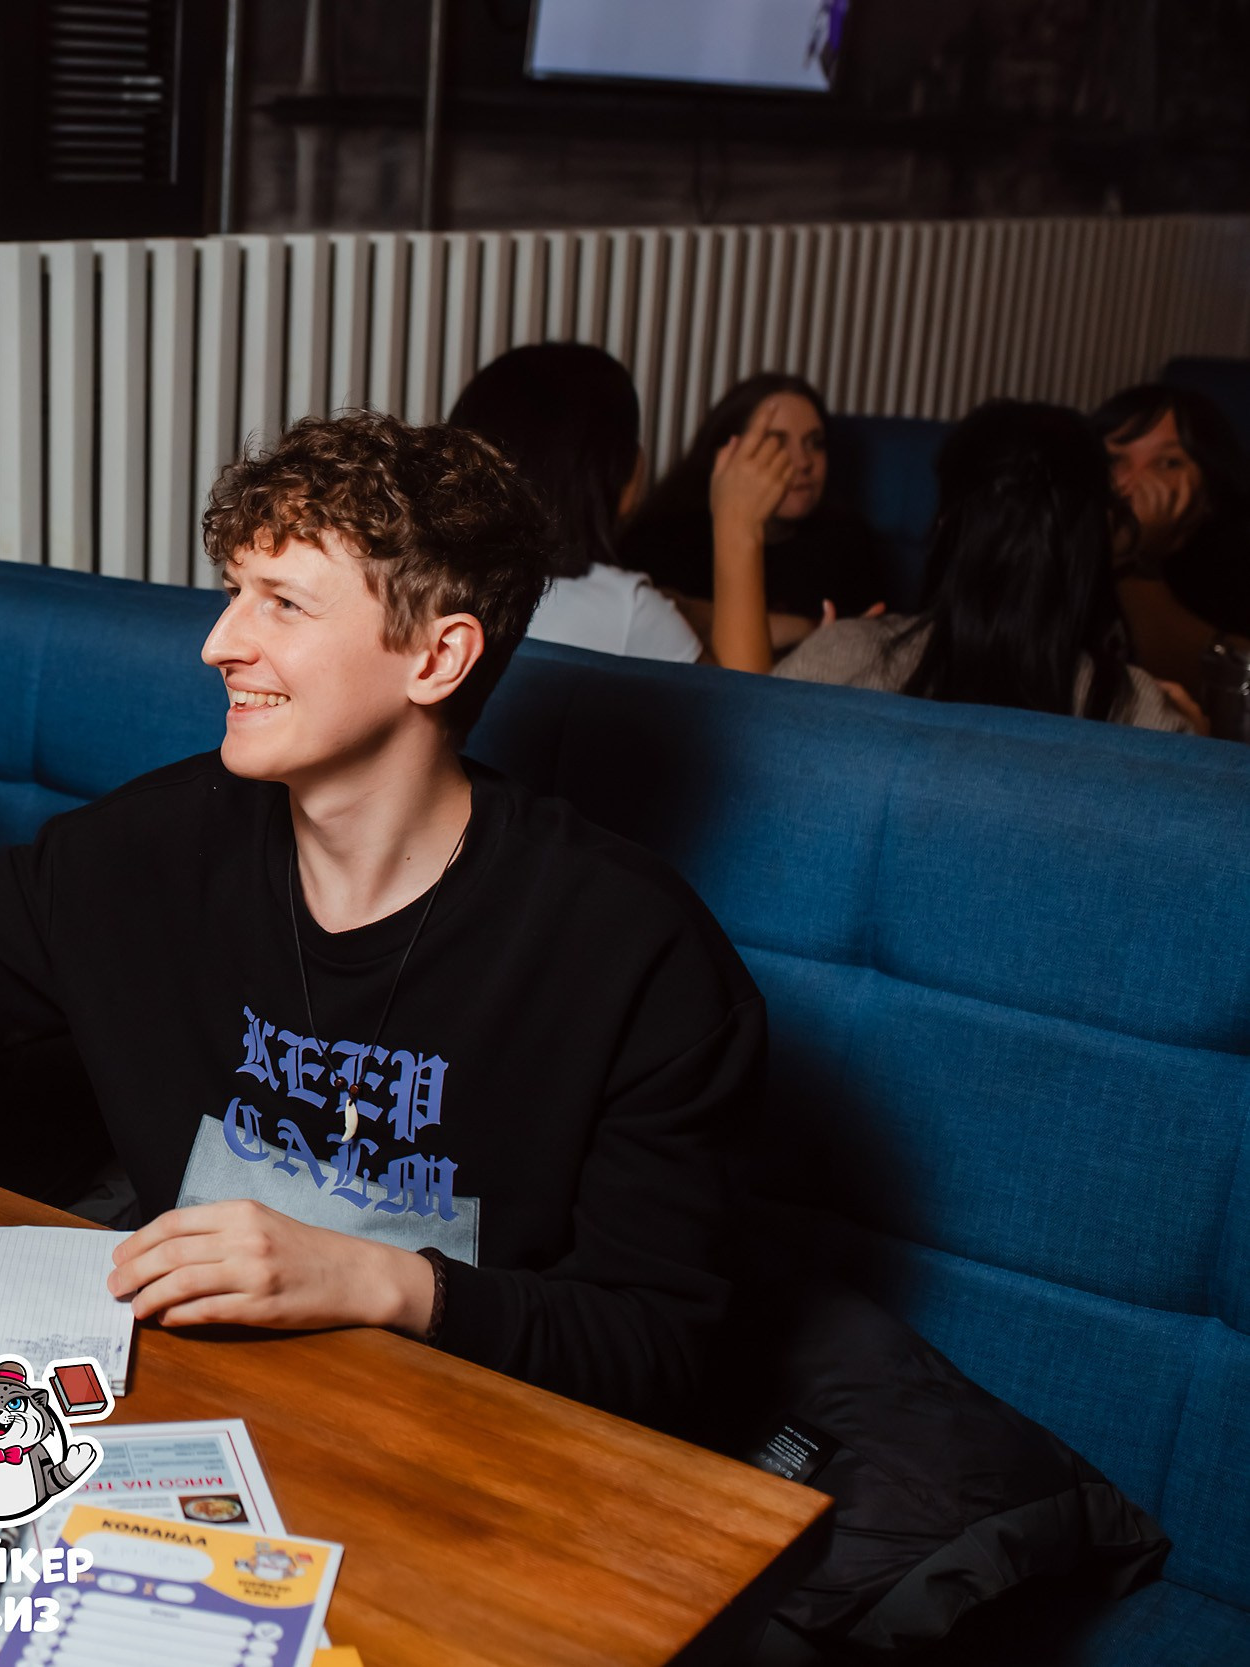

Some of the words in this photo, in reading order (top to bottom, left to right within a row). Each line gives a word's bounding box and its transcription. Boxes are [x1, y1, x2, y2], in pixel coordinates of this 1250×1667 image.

[236, 1006, 449, 1143] KEEP
[223, 1097, 459, 1221] CALM
[102, 1519, 208, 1547] КОМАНДА
